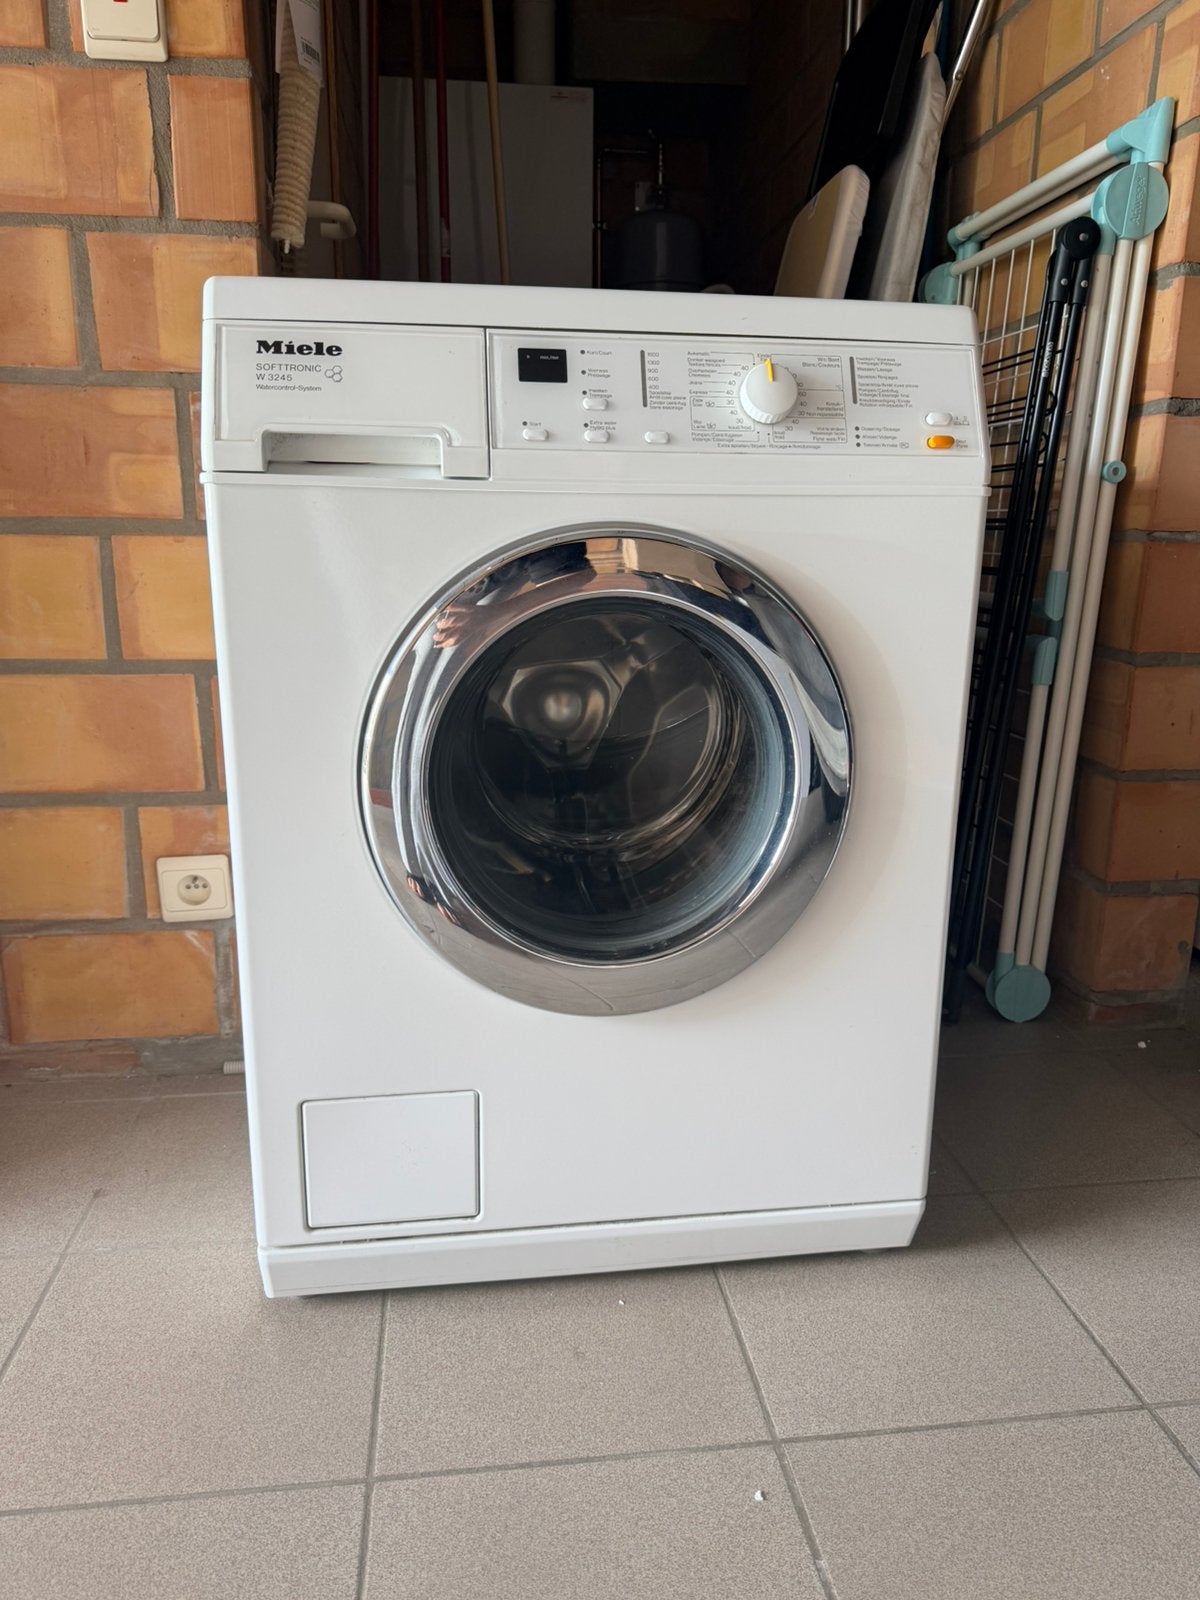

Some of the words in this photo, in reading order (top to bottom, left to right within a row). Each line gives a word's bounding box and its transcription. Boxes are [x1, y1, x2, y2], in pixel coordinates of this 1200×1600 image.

[256, 340, 343, 356] Miele
[256, 363, 322, 372] SOFTTRONIC
[256, 373, 266, 381] W
[267, 374, 293, 382] 3245
